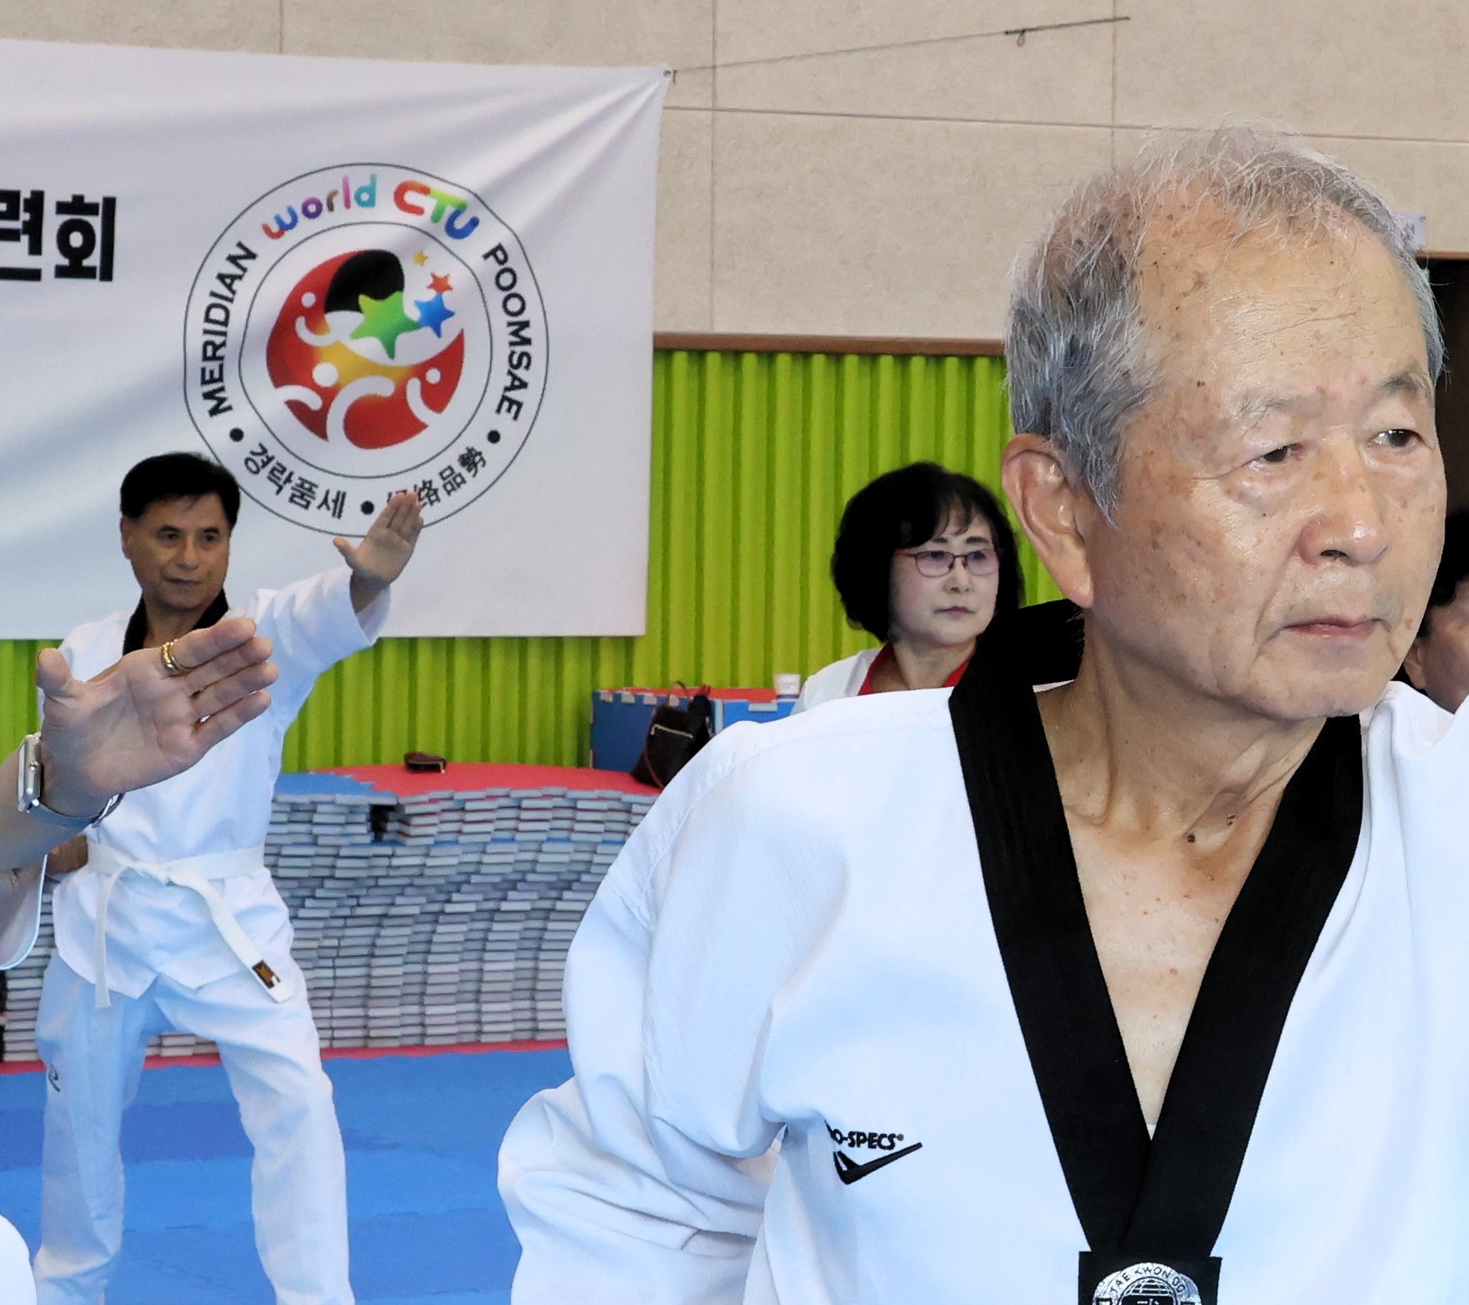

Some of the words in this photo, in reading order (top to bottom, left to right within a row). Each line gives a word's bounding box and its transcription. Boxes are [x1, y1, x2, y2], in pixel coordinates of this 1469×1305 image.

[200, 241, 259, 418] MERIDIAN
[262, 174, 378, 240] world
[393, 180, 480, 240] CTU
[482, 242, 533, 422] POOMSAE
[242, 442, 348, 520] 경락품세
